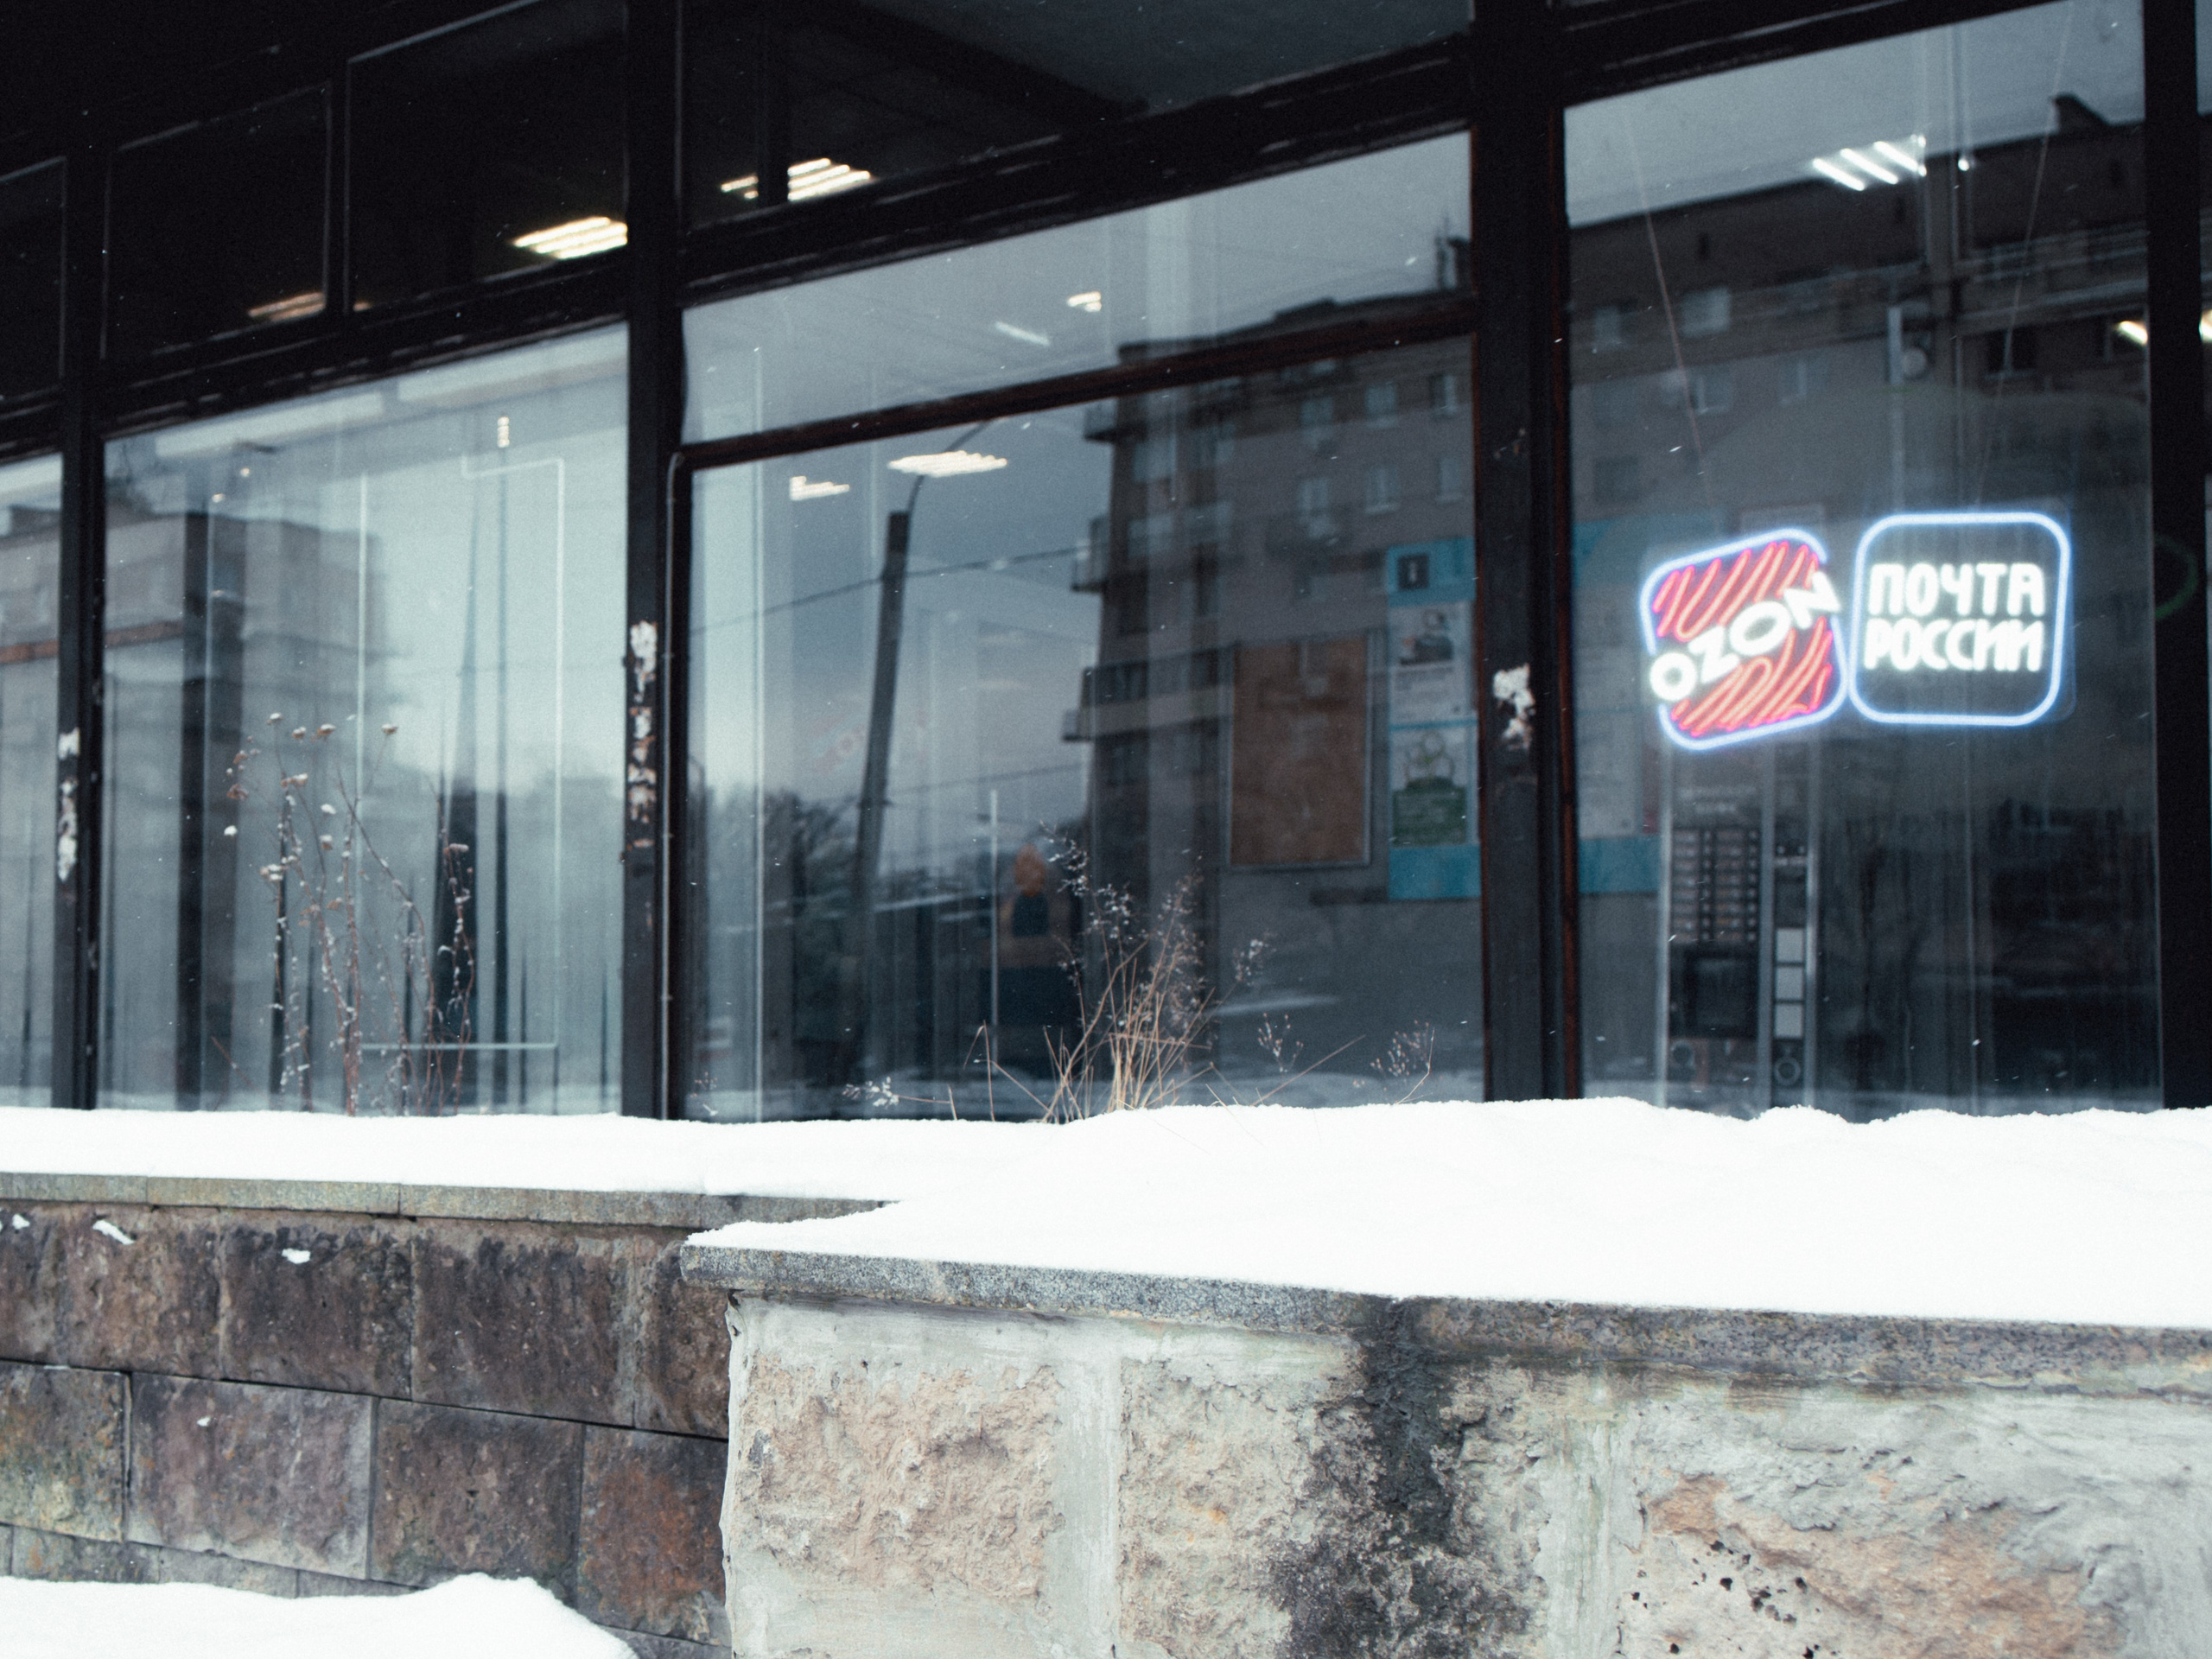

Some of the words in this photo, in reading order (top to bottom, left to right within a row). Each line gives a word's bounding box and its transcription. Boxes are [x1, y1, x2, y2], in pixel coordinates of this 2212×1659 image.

[1868, 562, 2046, 617] ПОЧТА
[1649, 569, 1842, 702] OZON
[1863, 617, 2045, 671] РОССИИ
